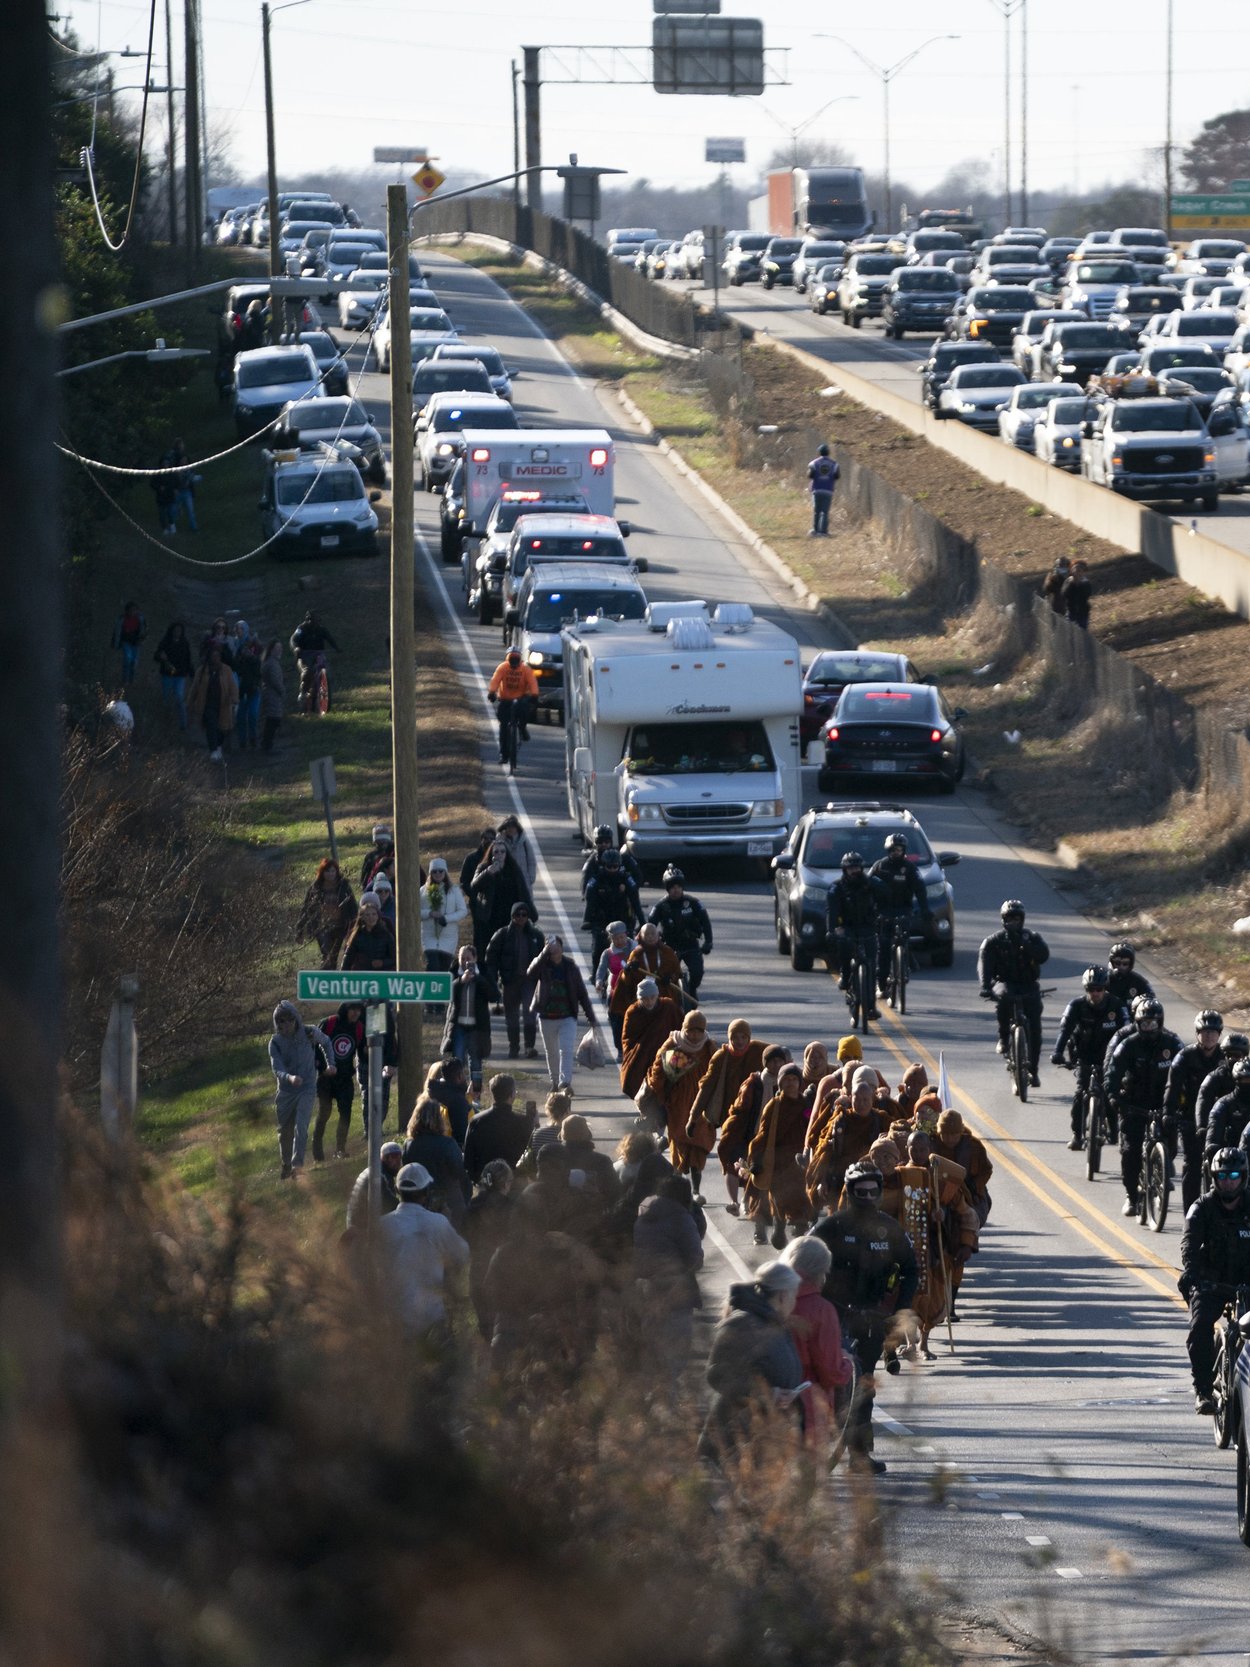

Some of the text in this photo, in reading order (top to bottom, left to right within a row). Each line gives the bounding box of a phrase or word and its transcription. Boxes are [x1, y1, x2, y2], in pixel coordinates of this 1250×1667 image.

[476, 465, 488, 476] 73
[516, 465, 568, 475] MEDIC
[307, 976, 444, 1001] Ventura Way Dr
[1102, 1021, 1117, 1029] POLICE
[870, 1241, 889, 1250] POLICE
